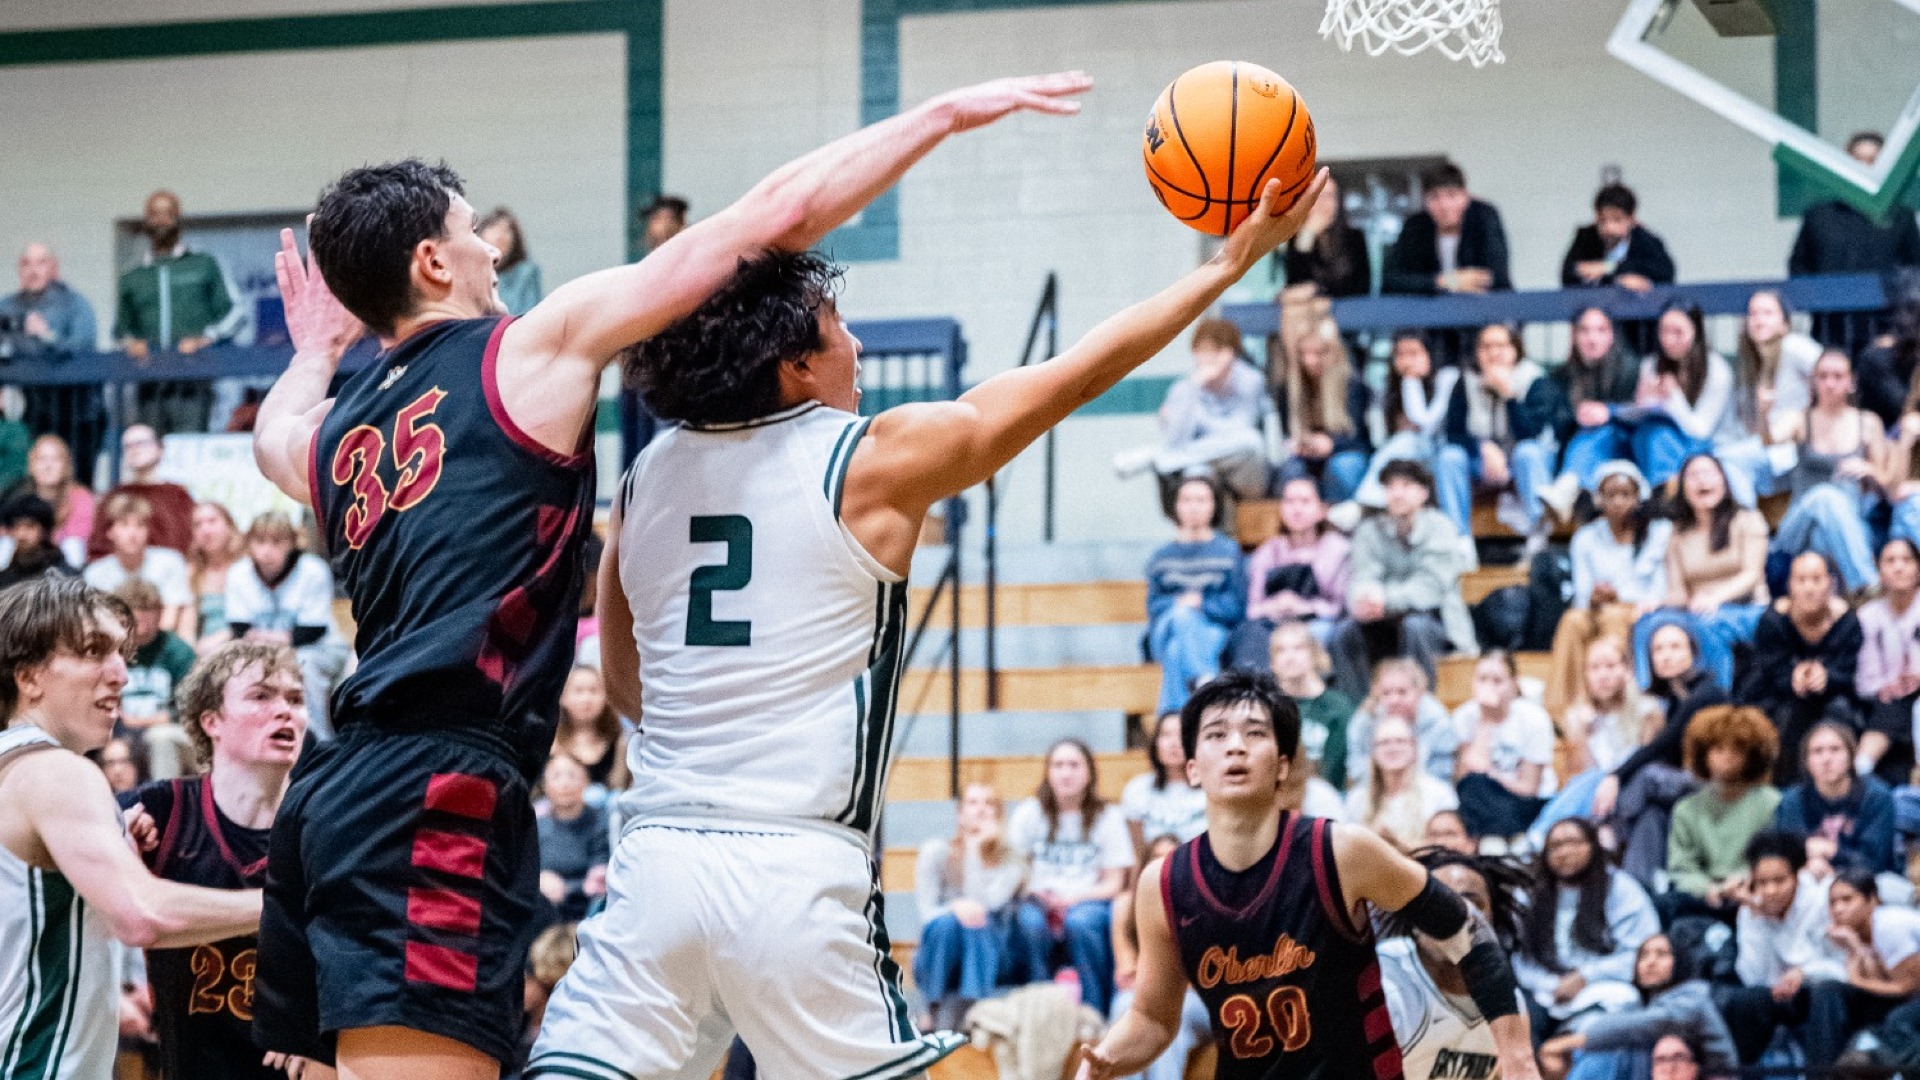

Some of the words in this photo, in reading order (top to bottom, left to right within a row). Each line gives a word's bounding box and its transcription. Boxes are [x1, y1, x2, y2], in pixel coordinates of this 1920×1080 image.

[332, 385, 449, 549] 35
[685, 514, 753, 647] 2
[188, 944, 257, 1021] 23
[1197, 932, 1316, 989] Oberlin
[1220, 985, 1311, 1059] 20
